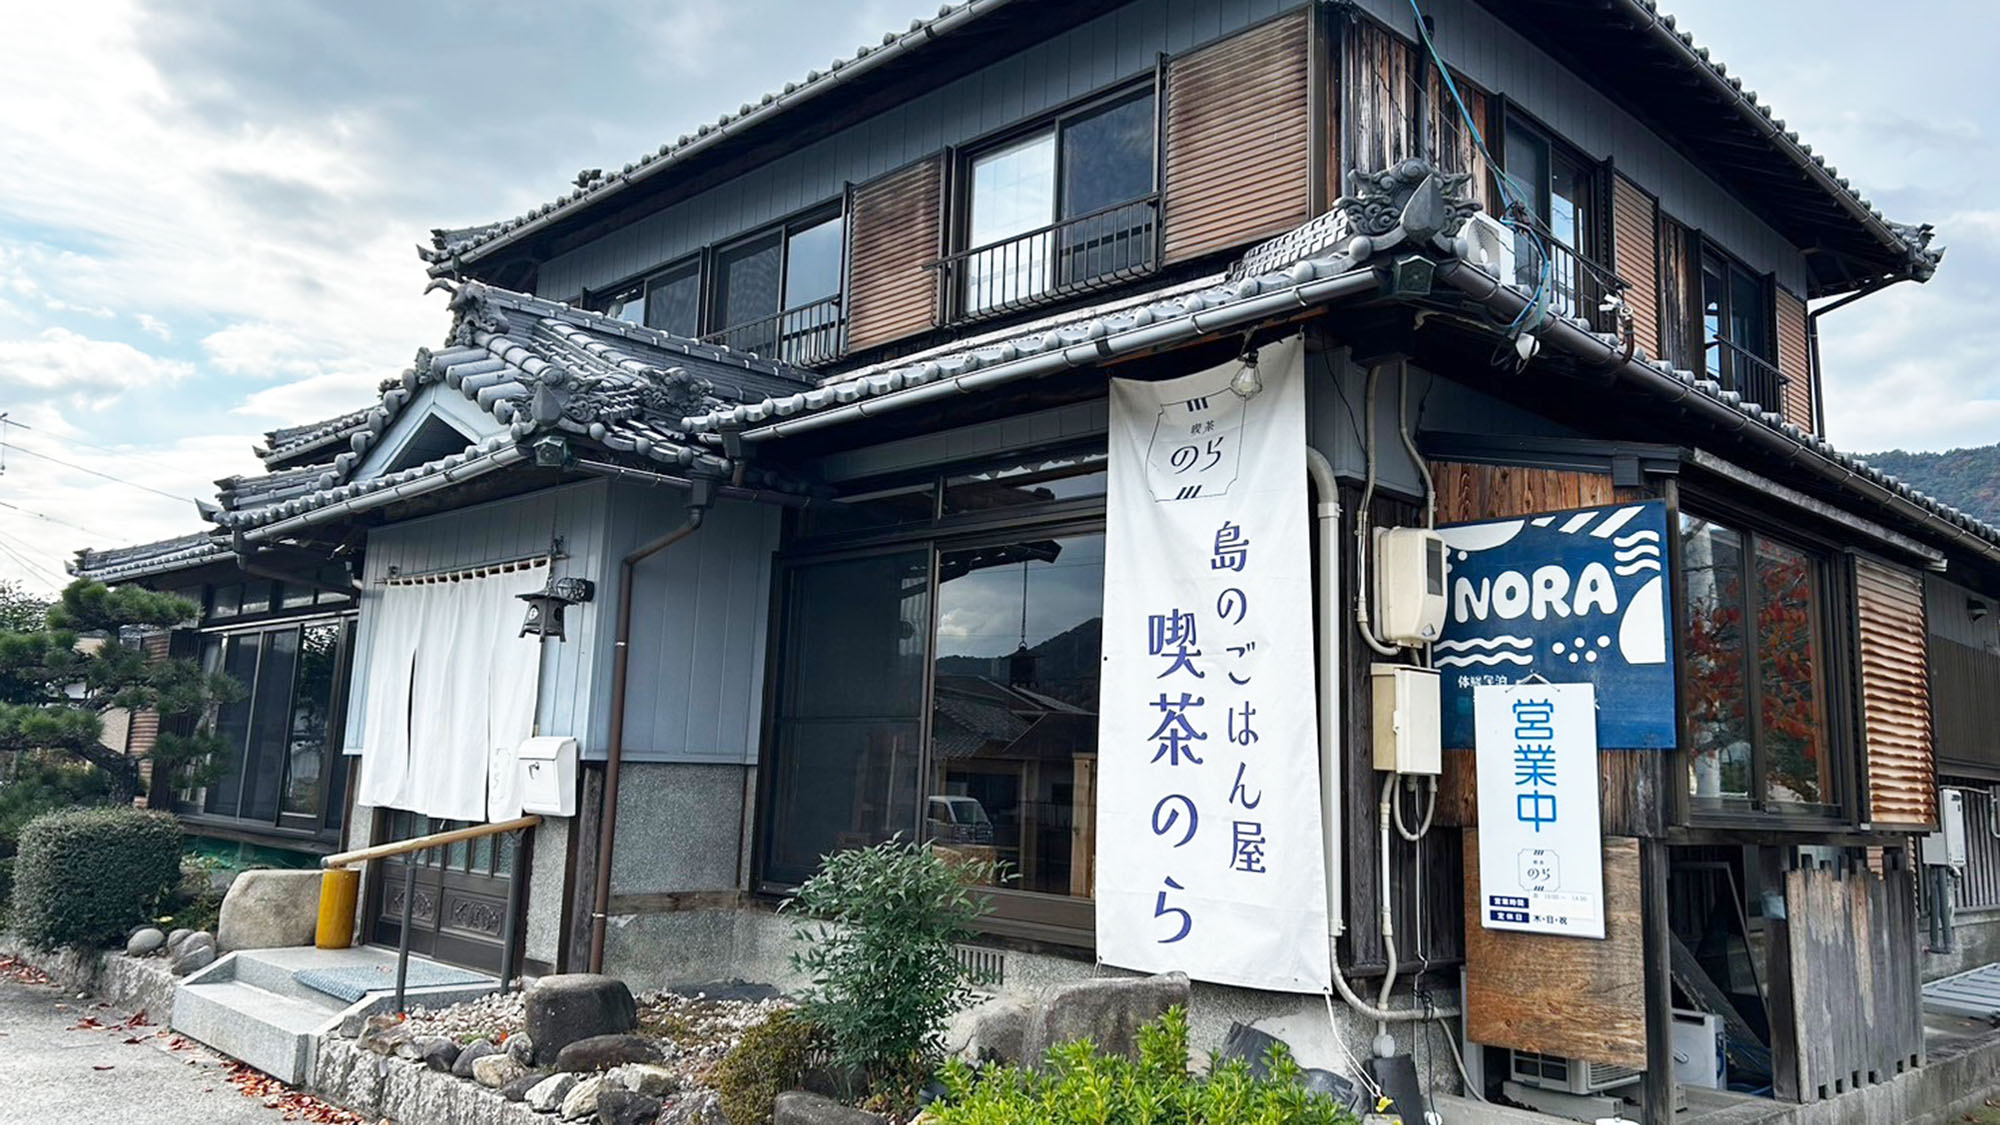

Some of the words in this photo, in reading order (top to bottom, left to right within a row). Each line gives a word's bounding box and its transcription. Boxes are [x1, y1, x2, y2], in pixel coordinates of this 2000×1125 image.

[1171, 436, 1224, 475] のら
[1454, 561, 1618, 624] NORA
[1210, 520, 1267, 874] 島のごはん屋
[1147, 608, 1208, 944] 喫茶のら
[1512, 698, 1557, 833] 営業中
[1527, 867, 1551, 882] のら
